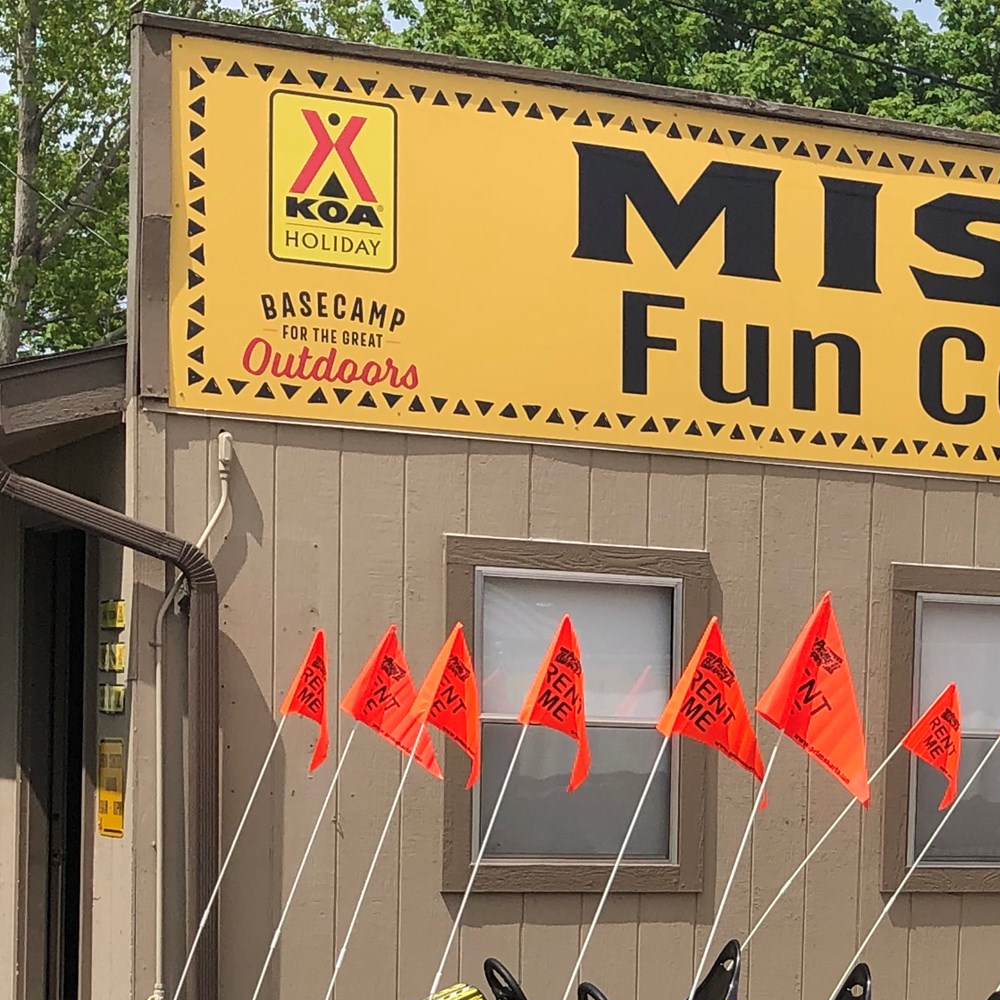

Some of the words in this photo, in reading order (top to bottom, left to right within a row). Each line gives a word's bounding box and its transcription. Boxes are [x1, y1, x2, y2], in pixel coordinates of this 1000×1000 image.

[285, 196, 384, 228] KOA
[285, 230, 382, 256] HOLIDAY
[261, 291, 406, 332] BASECAMP
[282, 324, 307, 342] FOR
[312, 327, 338, 344] THE
[342, 330, 384, 349] GREAT
[621, 290, 862, 416] Fun
[242, 337, 419, 390] Outdoors
[297, 687, 322, 713] ME
[374, 675, 400, 711] NT
[538, 689, 573, 722] ME
[690, 670, 736, 725] RENT
[798, 668, 831, 716] NT
[681, 696, 717, 732] ME
[923, 735, 944, 760] ME
[929, 718, 957, 756] RENT
